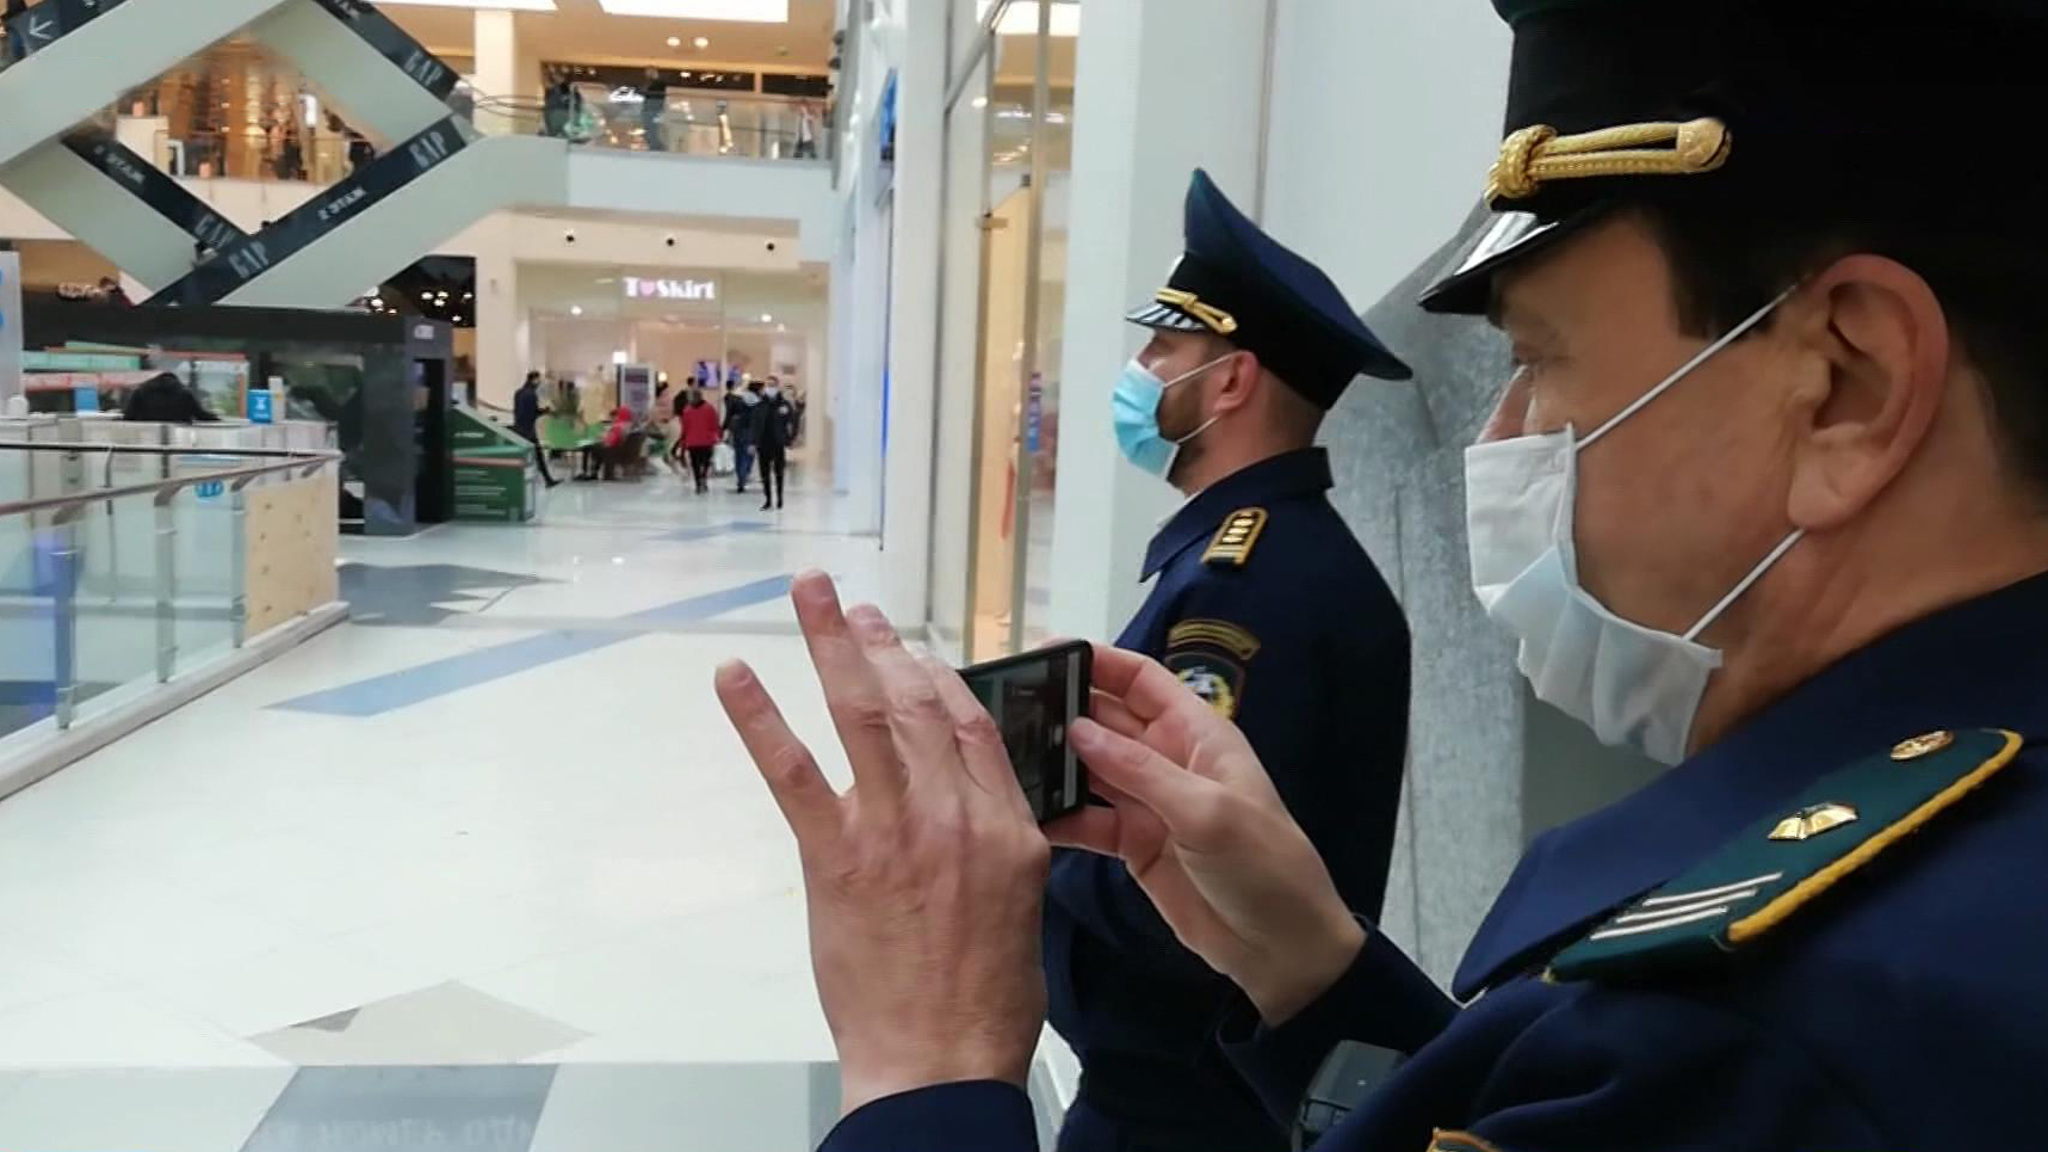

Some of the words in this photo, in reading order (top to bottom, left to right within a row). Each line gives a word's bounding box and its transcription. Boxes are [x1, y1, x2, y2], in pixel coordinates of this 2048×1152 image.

[403, 50, 443, 87] GAP
[409, 131, 447, 168] GAP
[228, 241, 269, 278] GAP
